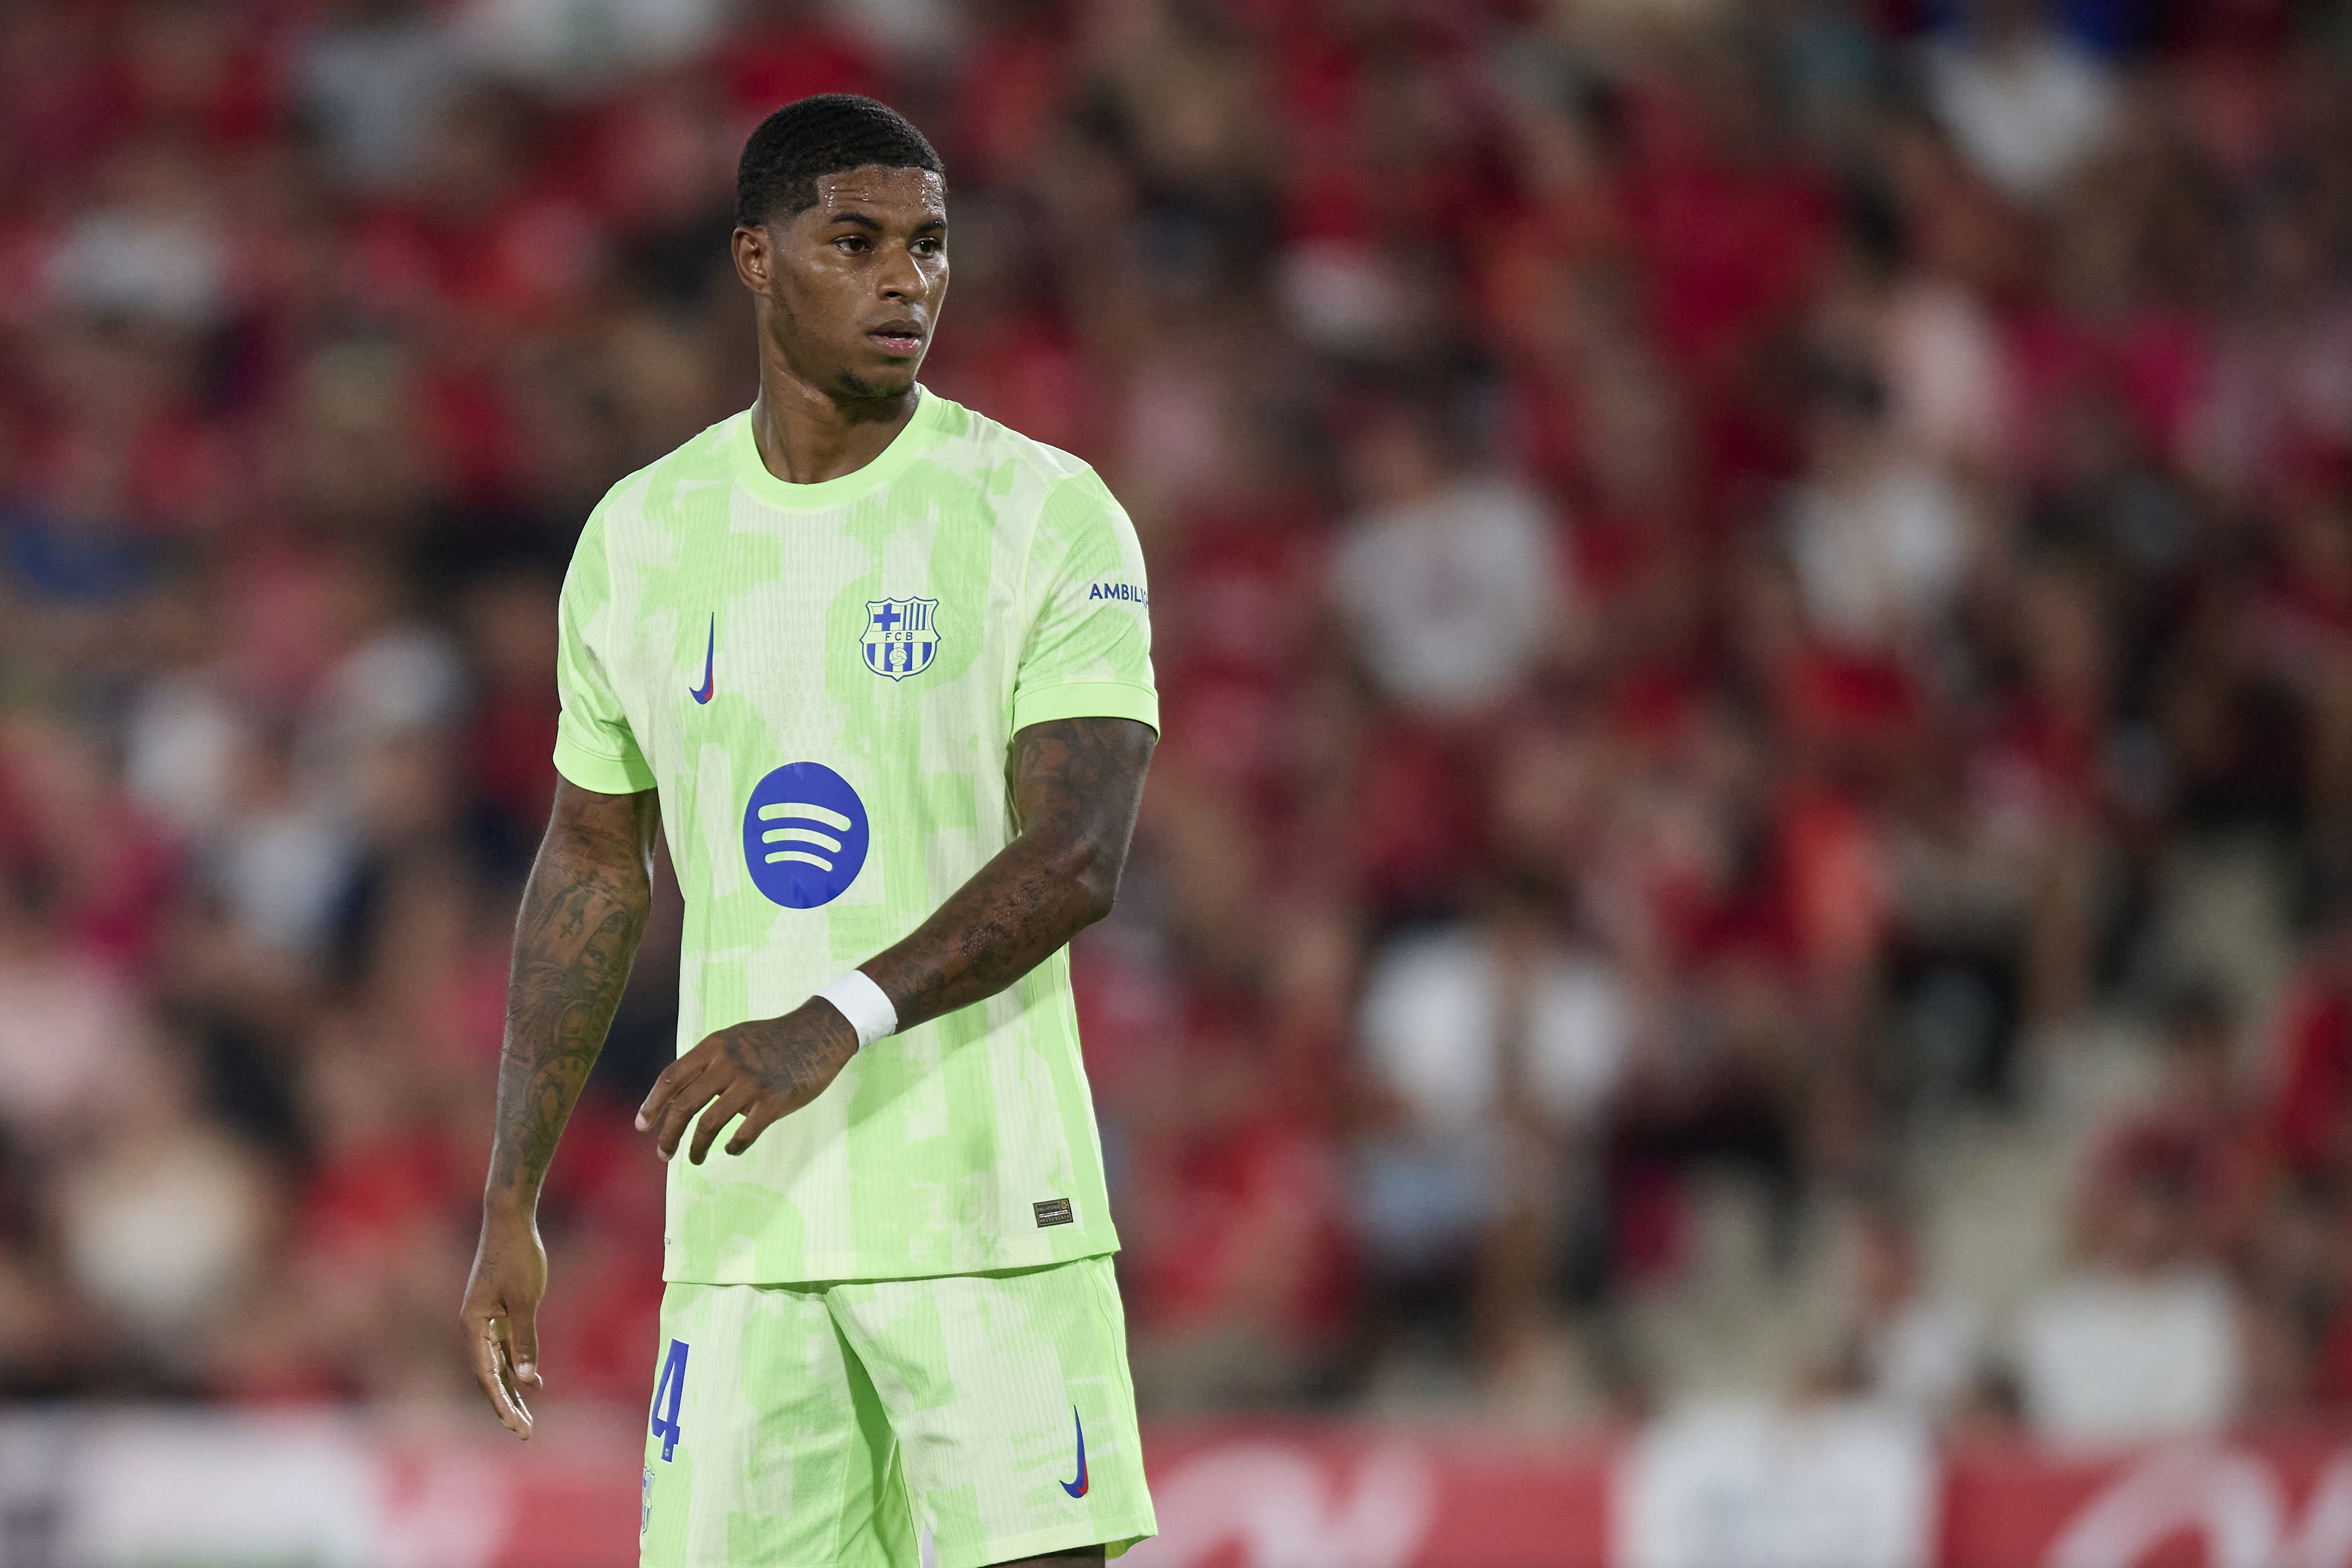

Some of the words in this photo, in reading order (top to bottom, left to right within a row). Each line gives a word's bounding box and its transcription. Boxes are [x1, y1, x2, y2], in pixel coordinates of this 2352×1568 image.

[1089, 583, 1148, 609] AMBILI
[885, 631, 913, 641] FCB
[651, 1338, 689, 1463] 4
